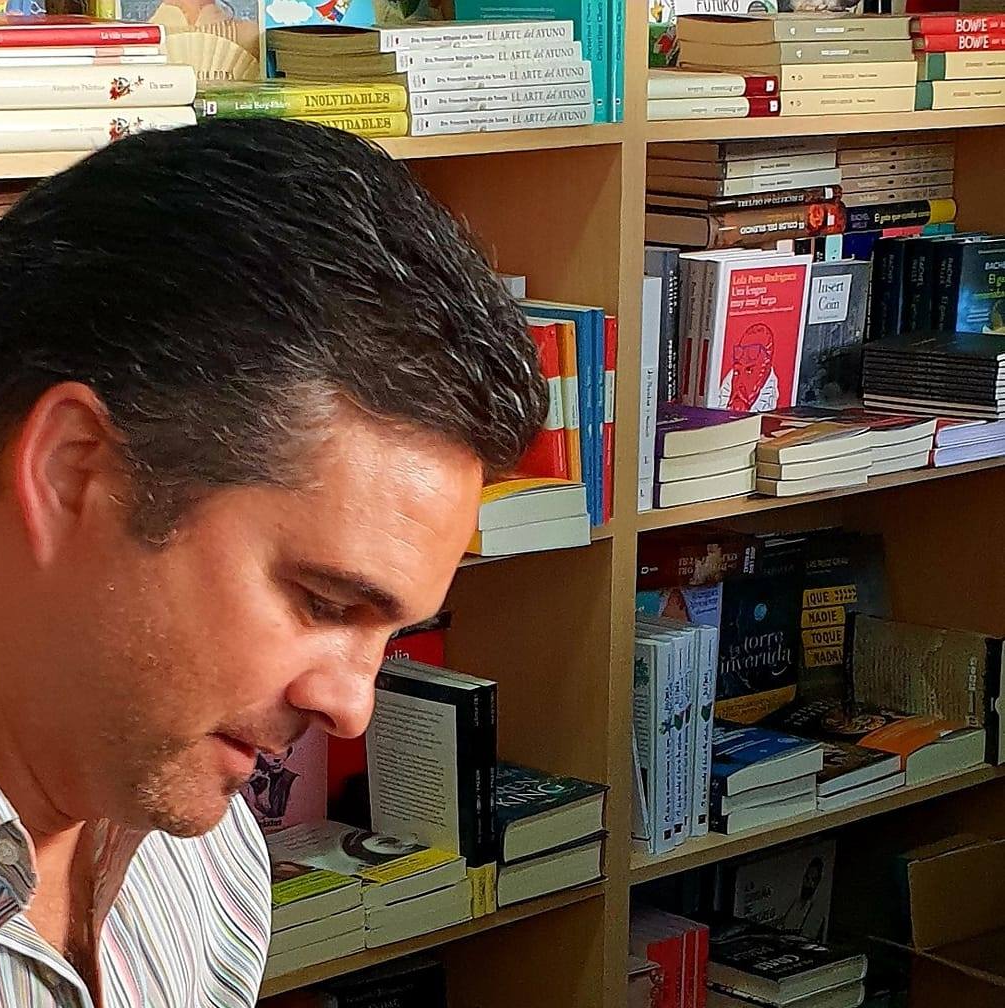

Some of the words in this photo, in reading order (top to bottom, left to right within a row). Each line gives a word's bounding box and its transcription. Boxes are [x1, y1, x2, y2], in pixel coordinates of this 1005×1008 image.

[956, 18, 988, 32] BOWIE
[487, 30, 497, 40] EL
[499, 29, 523, 40] ARTE
[534, 27, 566, 37] AYUNO
[958, 35, 989, 49] BOWIE
[498, 50, 508, 60] EL
[509, 49, 534, 60] ARTE
[545, 47, 575, 57] AYUNO
[510, 70, 519, 80] EL
[520, 69, 543, 79] ARTE
[555, 66, 584, 77] AYUNO
[304, 93, 390, 107] INOLVIDABLES
[511, 91, 521, 102] EL
[522, 90, 544, 101] ARTE
[556, 88, 586, 99] AYUNO
[512, 113, 522, 124] EL
[523, 112, 545, 123] ARTE
[557, 110, 587, 121] AYUNO
[808, 610, 838, 623] NADIE
[811, 630, 843, 644] TOQUE
